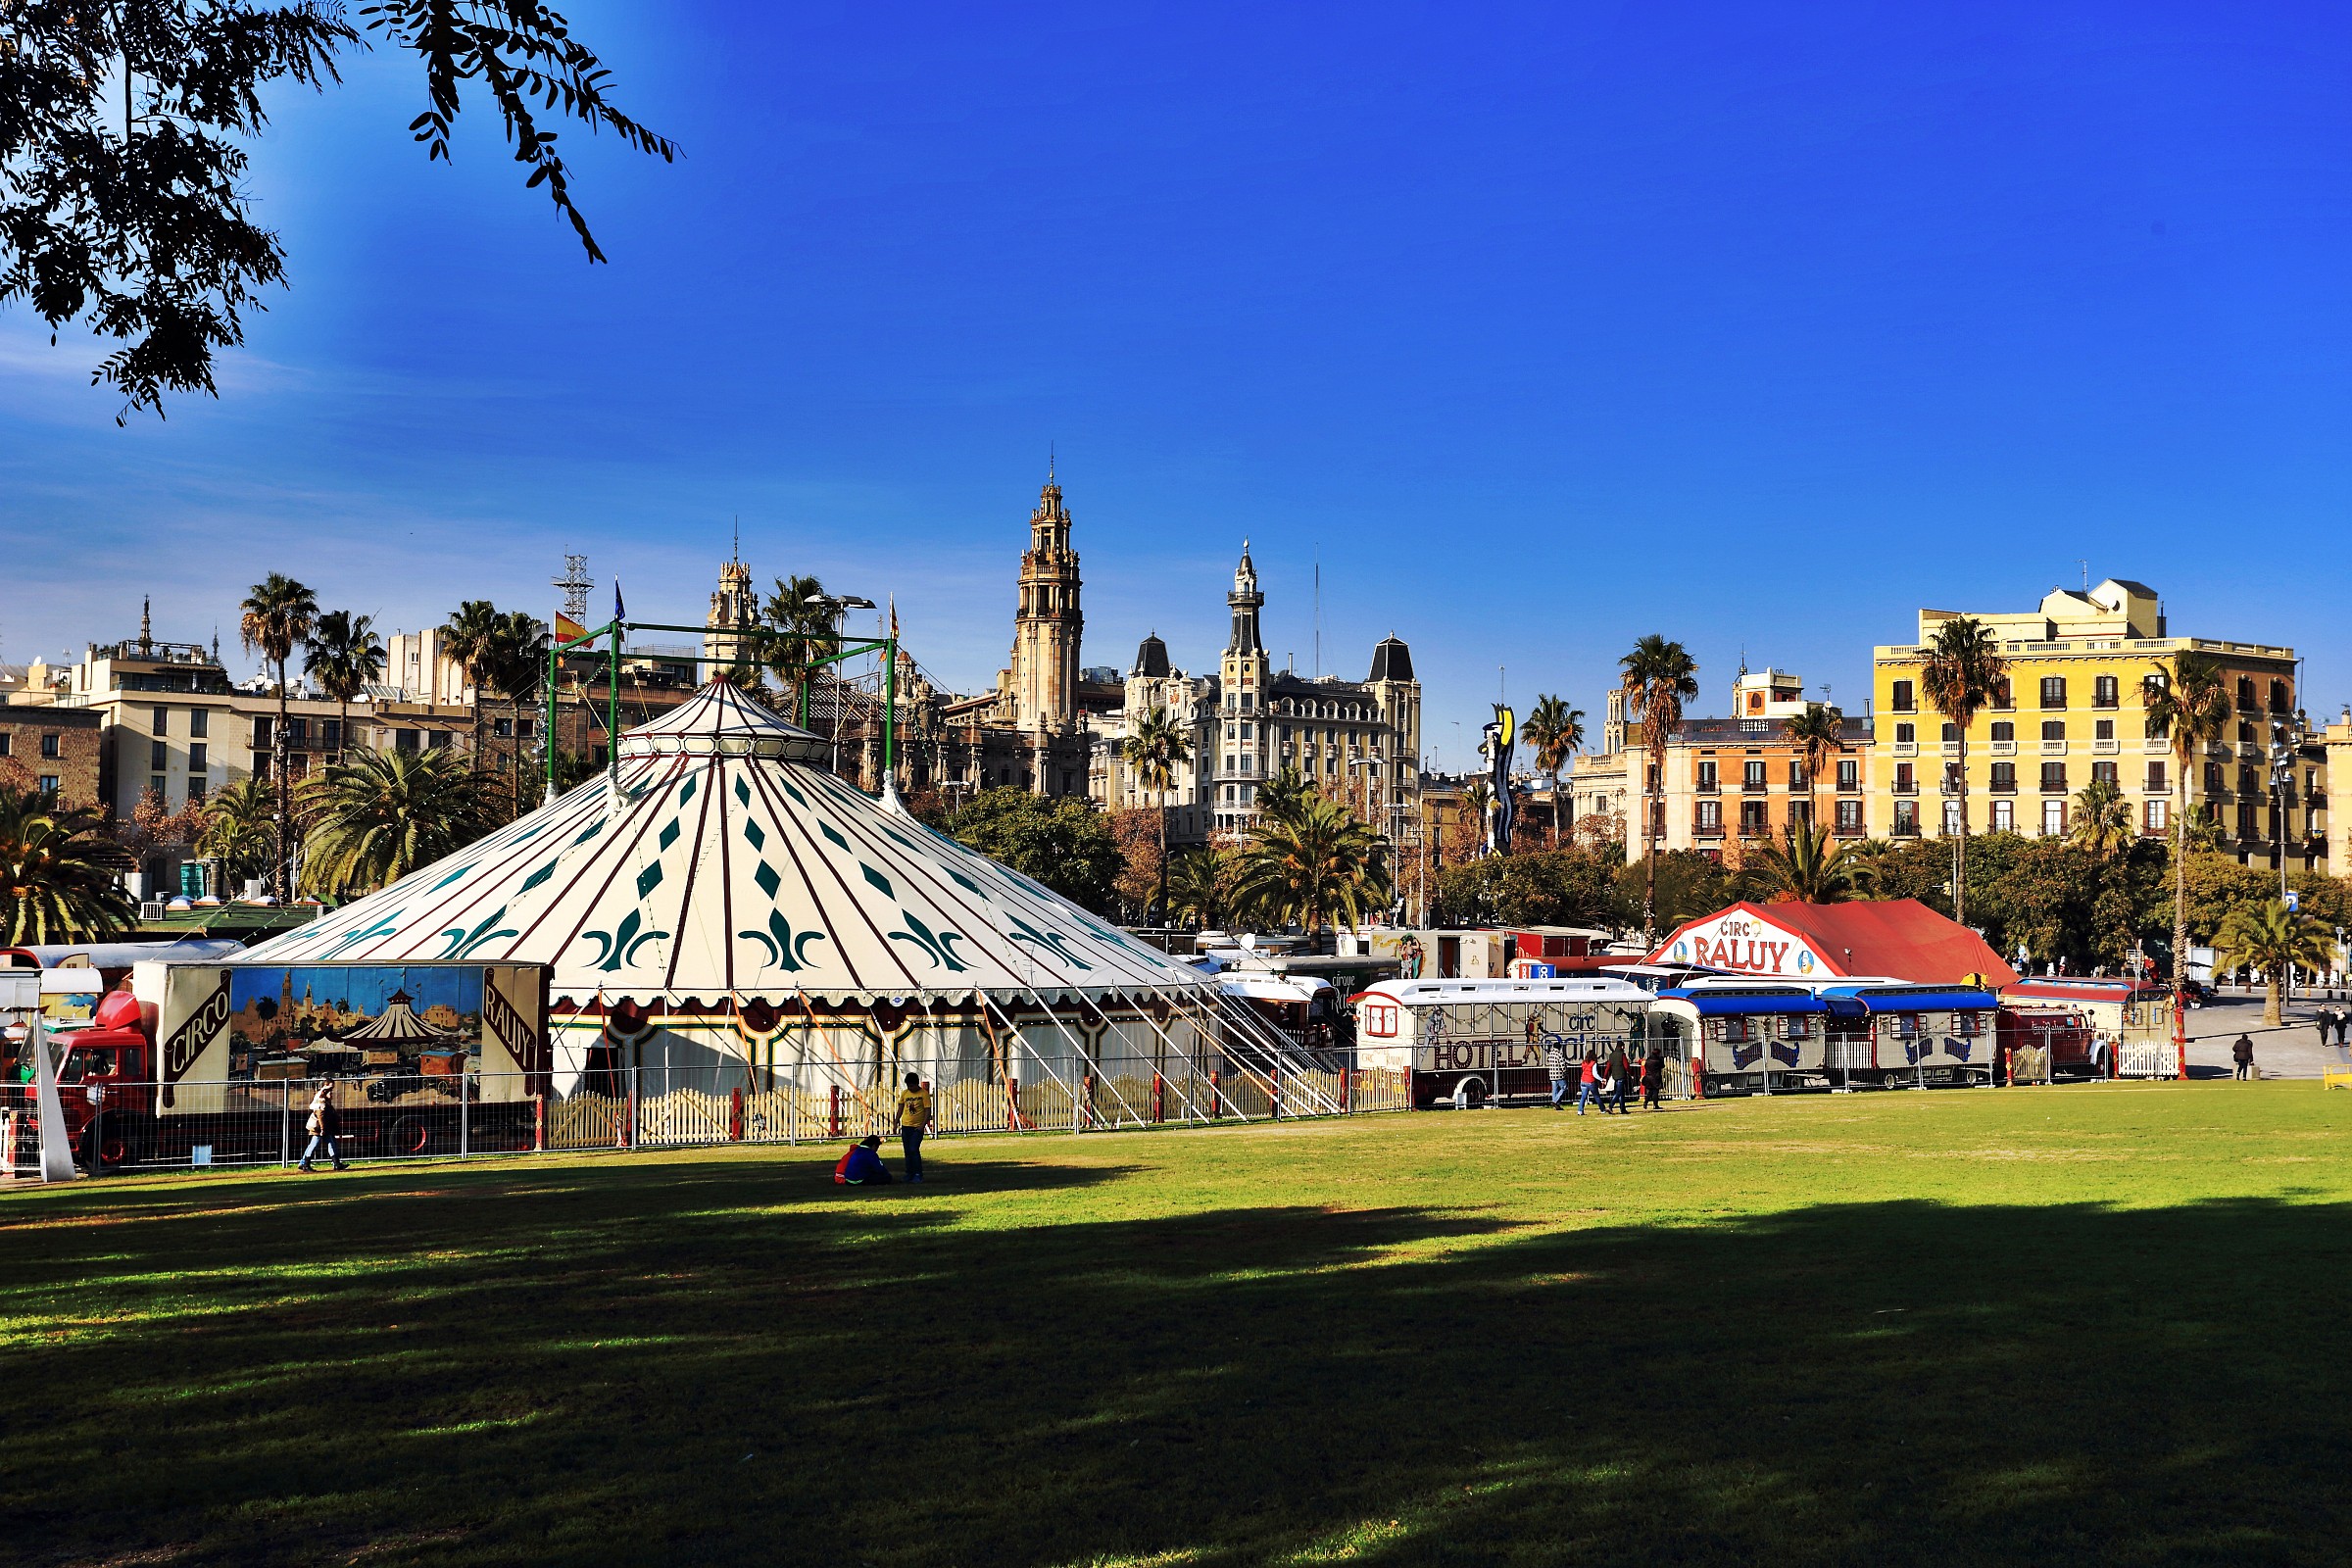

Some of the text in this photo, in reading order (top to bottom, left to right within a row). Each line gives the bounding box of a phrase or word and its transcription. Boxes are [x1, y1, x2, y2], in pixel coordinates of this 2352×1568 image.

[1693, 936, 1789, 973] RALUY
[1332, 972, 1355, 987] cirque
[172, 991, 228, 1072] CIRCO
[485, 984, 530, 1068] RALUY
[1568, 1014, 1594, 1032] circ
[1434, 1039, 1523, 1070] HOTEL
